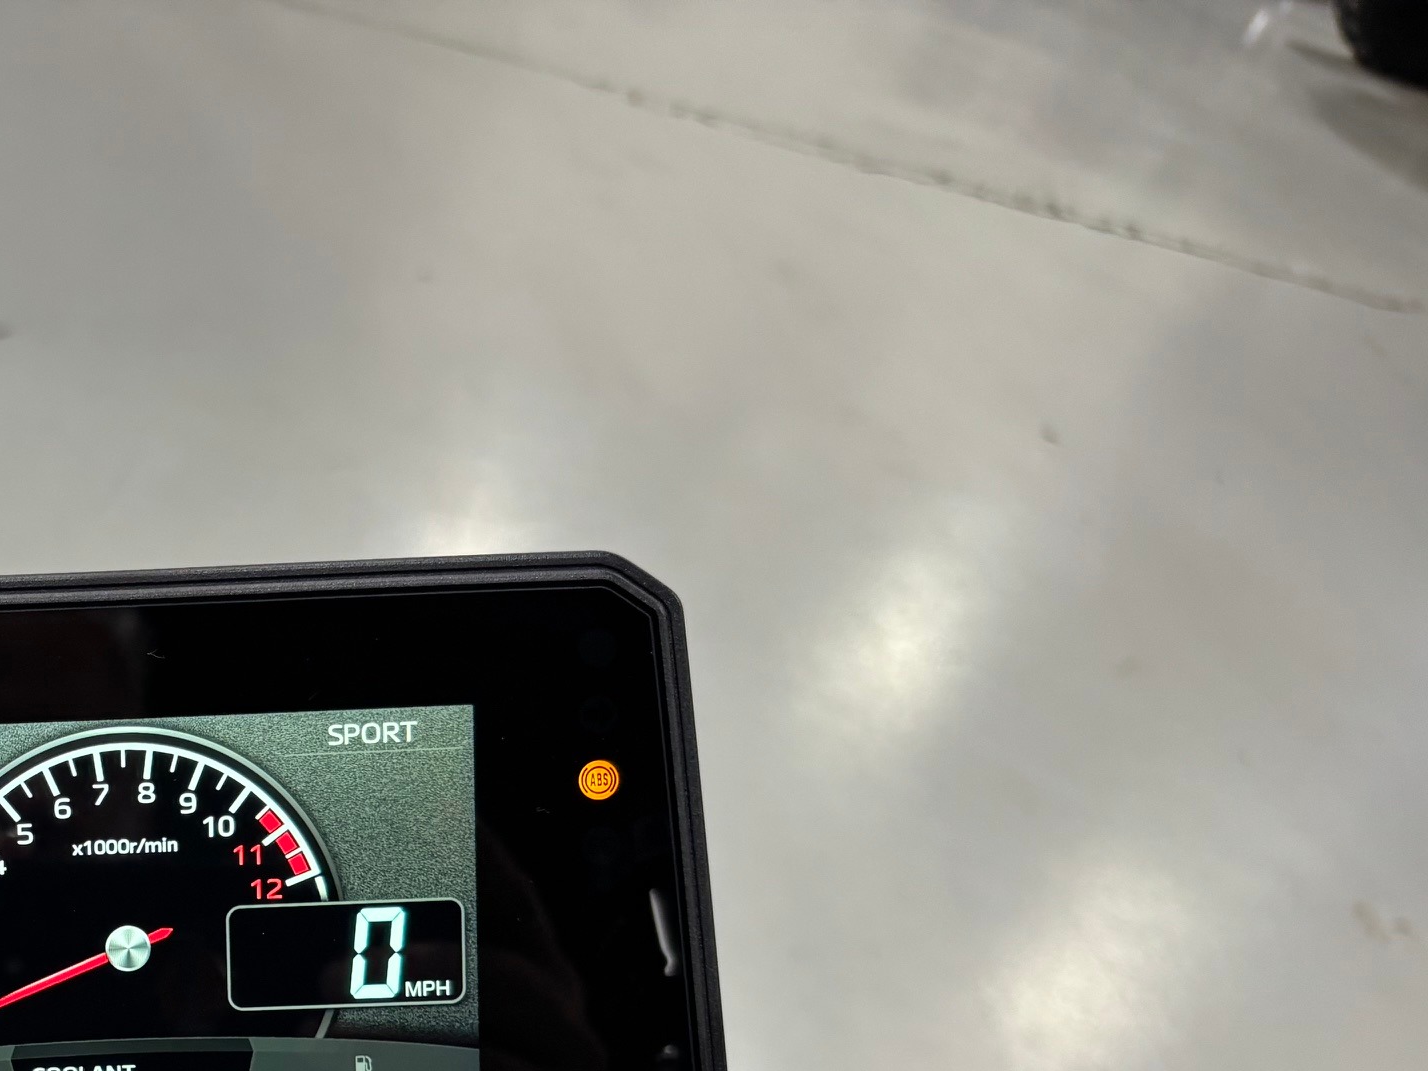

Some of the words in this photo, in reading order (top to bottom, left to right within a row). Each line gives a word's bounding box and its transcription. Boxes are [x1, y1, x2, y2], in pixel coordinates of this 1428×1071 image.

[327, 721, 418, 745] SPORT
[590, 772, 609, 787] ABS
[92, 783, 109, 806] 7
[137, 782, 156, 804] 8
[178, 792, 197, 815] 9
[53, 797, 72, 820] 6
[16, 823, 34, 845] 5
[202, 815, 235, 838] 10
[71, 837, 179, 857] x1000r/min
[233, 844, 261, 866] 11
[250, 878, 283, 900] 12
[349, 906, 406, 1000] 0
[404, 979, 452, 998] MPH
